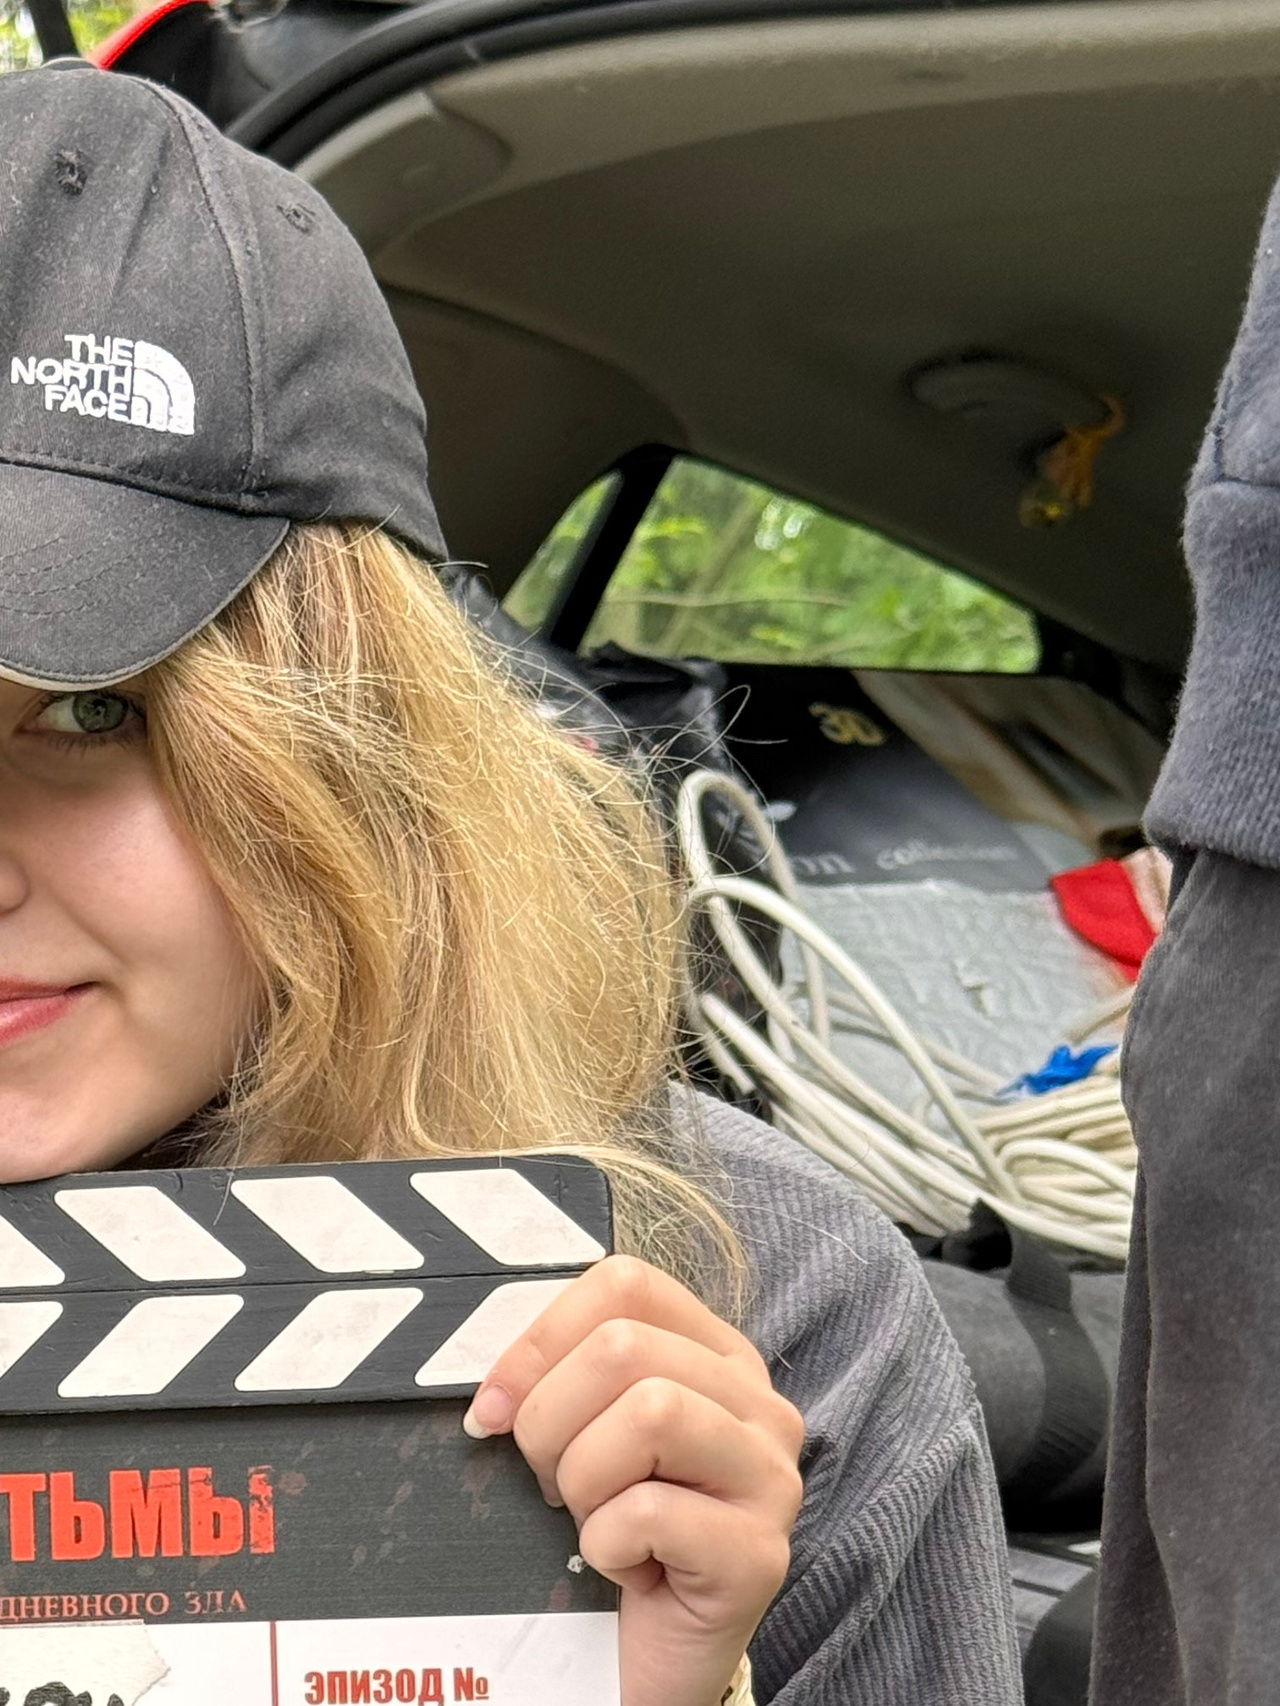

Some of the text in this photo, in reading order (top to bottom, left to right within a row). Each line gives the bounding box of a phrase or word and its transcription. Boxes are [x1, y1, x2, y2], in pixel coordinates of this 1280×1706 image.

[64, 333, 134, 366] THE
[10, 356, 133, 396] NORTH
[44, 384, 131, 424] FACE
[183, 1589, 248, 1615] ЗЛА
[453, 1667, 489, 1701] №
